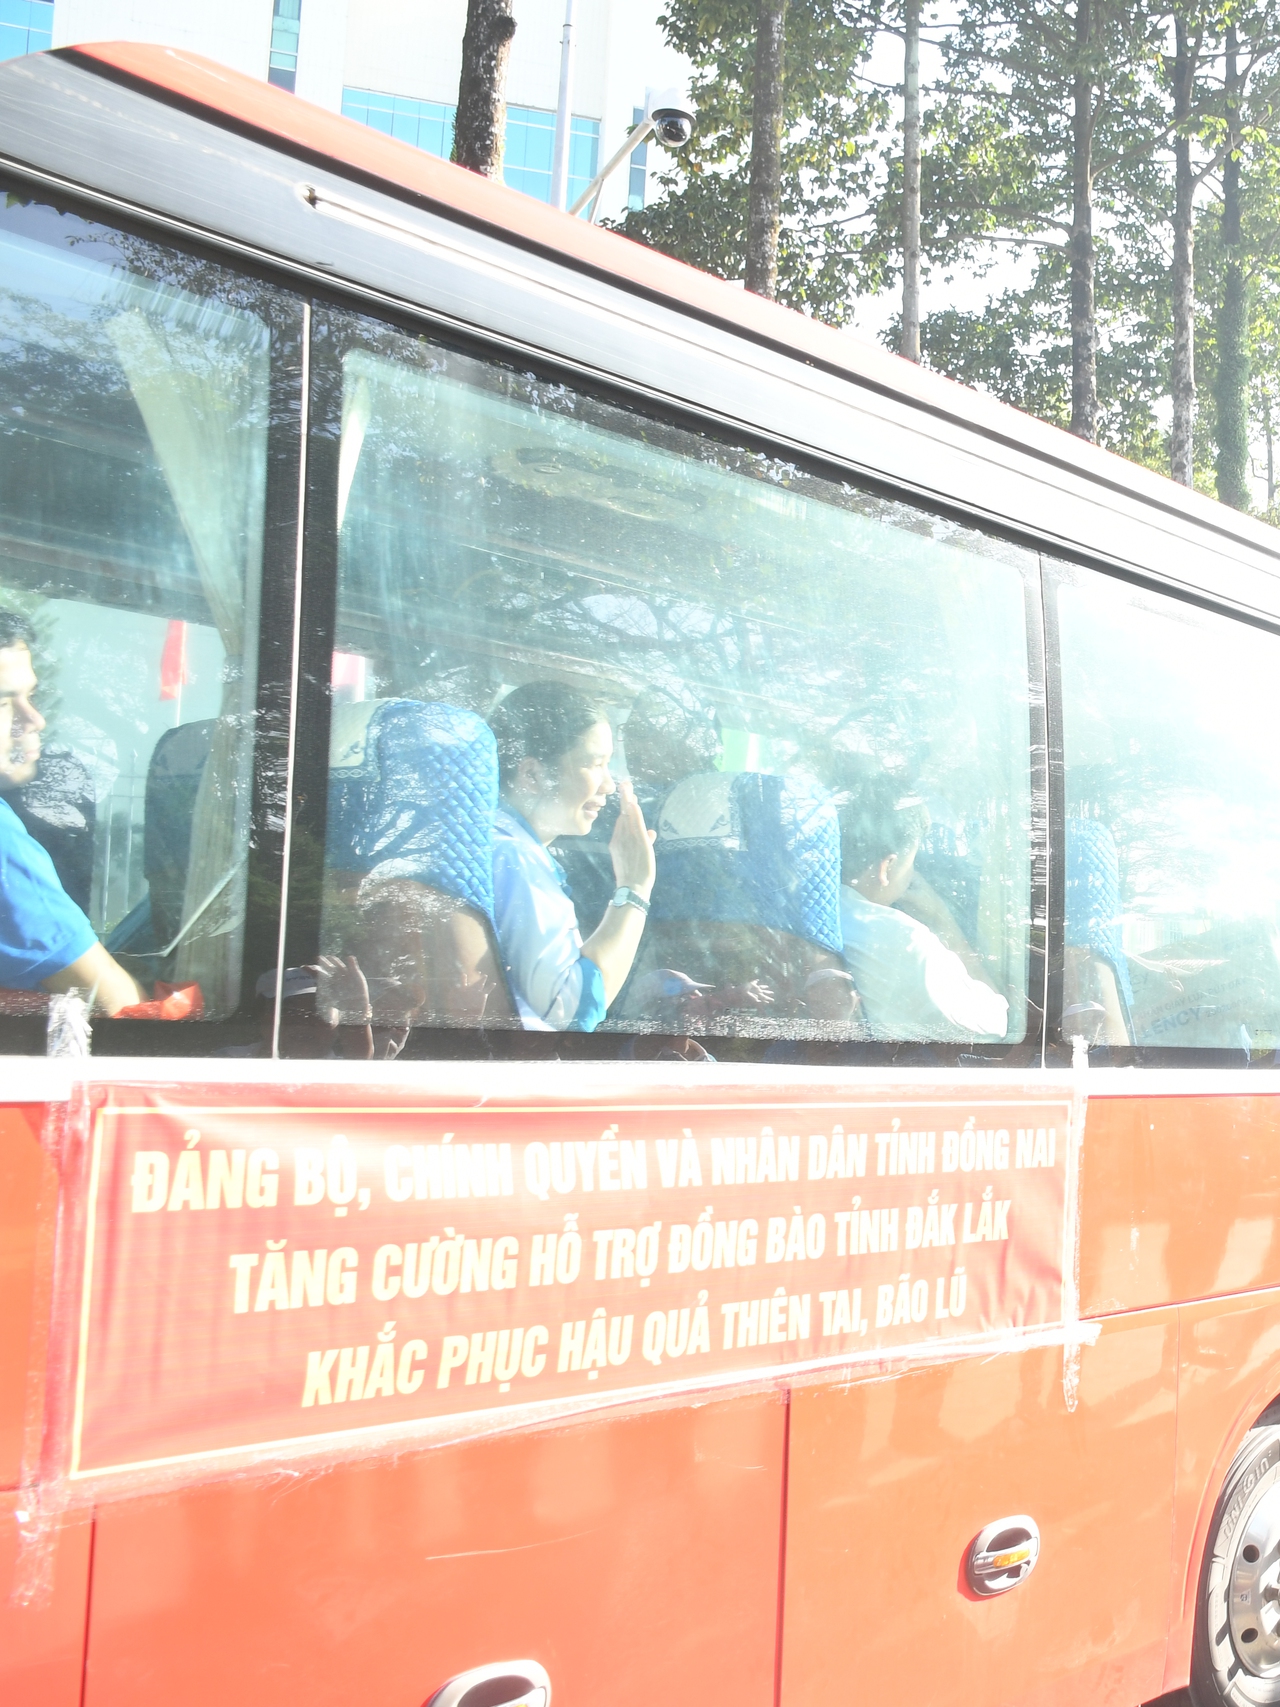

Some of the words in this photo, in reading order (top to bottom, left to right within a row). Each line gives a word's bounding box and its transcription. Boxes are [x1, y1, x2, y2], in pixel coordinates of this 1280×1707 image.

[131, 1129, 280, 1213] ĐẢNG
[293, 1133, 371, 1217] BỘ,
[383, 1132, 516, 1203] CHÍNH
[523, 1124, 649, 1200] QUYỀN
[656, 1128, 704, 1188] VÀ
[711, 1127, 801, 1185] NHÂN
[807, 1124, 868, 1180] DÂN
[875, 1117, 936, 1177] TỈNH
[941, 1116, 1011, 1172] ĐỒNG
[1015, 1128, 1057, 1169] NAI
[228, 1238, 359, 1314] TĂNG
[371, 1226, 519, 1299] CƯỜNG
[529, 1212, 583, 1288] HỖ
[592, 1221, 663, 1288] TRỢ
[667, 1206, 759, 1274] ĐỒNG
[765, 1206, 827, 1264] BÀO
[834, 1195, 900, 1257] TỈNH
[905, 1188, 957, 1247] ĐẮK
[962, 1185, 1012, 1244] LẮK
[301, 1321, 428, 1408] KHẮC
[436, 1324, 550, 1395] PHỤC
[556, 1307, 635, 1381] HẬU
[641, 1289, 711, 1365] QUẢ
[720, 1286, 812, 1350] THIÊN
[817, 1287, 868, 1338] TAI,
[875, 1272, 930, 1326] BÃO
[934, 1266, 968, 1320] LŨ
